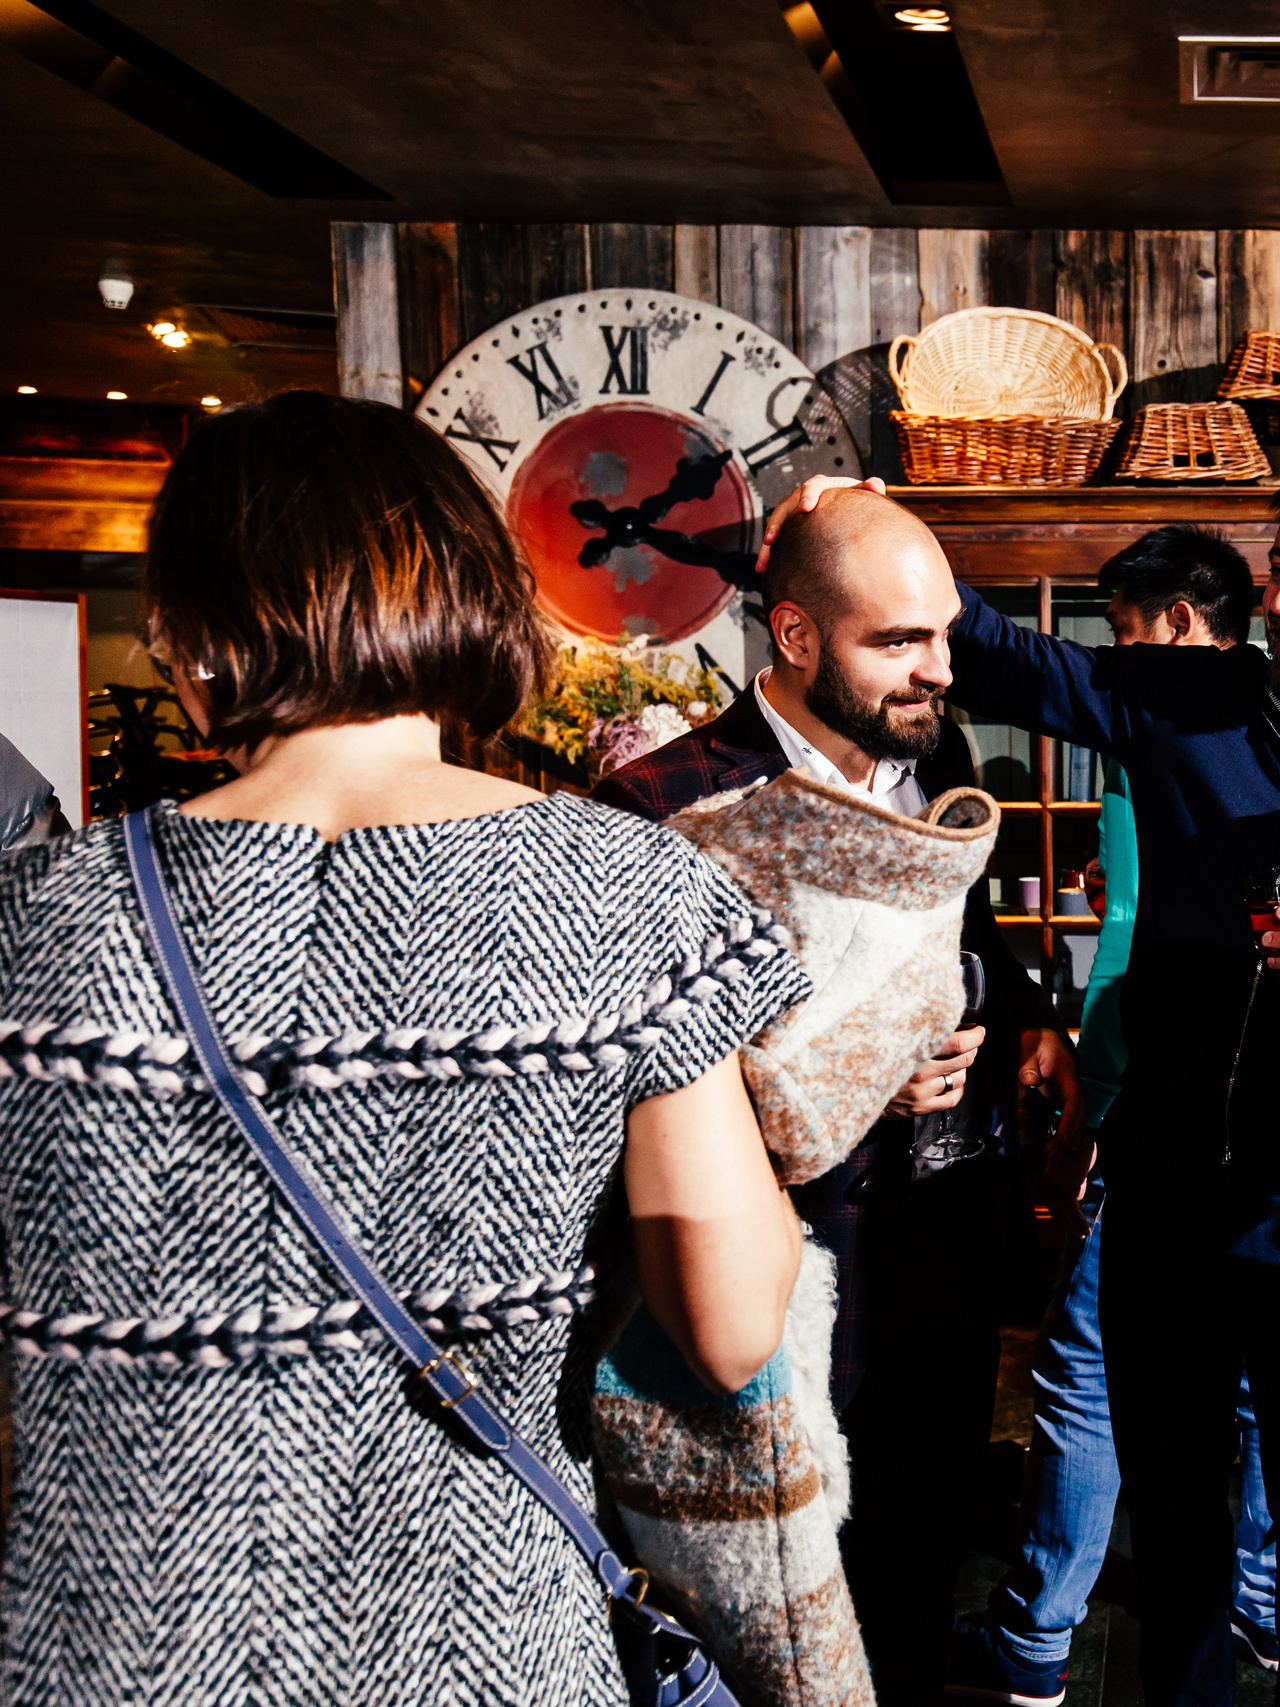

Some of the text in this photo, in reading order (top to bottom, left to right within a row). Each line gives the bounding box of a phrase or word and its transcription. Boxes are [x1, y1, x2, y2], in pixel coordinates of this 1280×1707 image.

[506, 340, 580, 421] XI
[599, 325, 650, 395] XII
[444, 407, 521, 473] X
[739, 416, 813, 478] II
